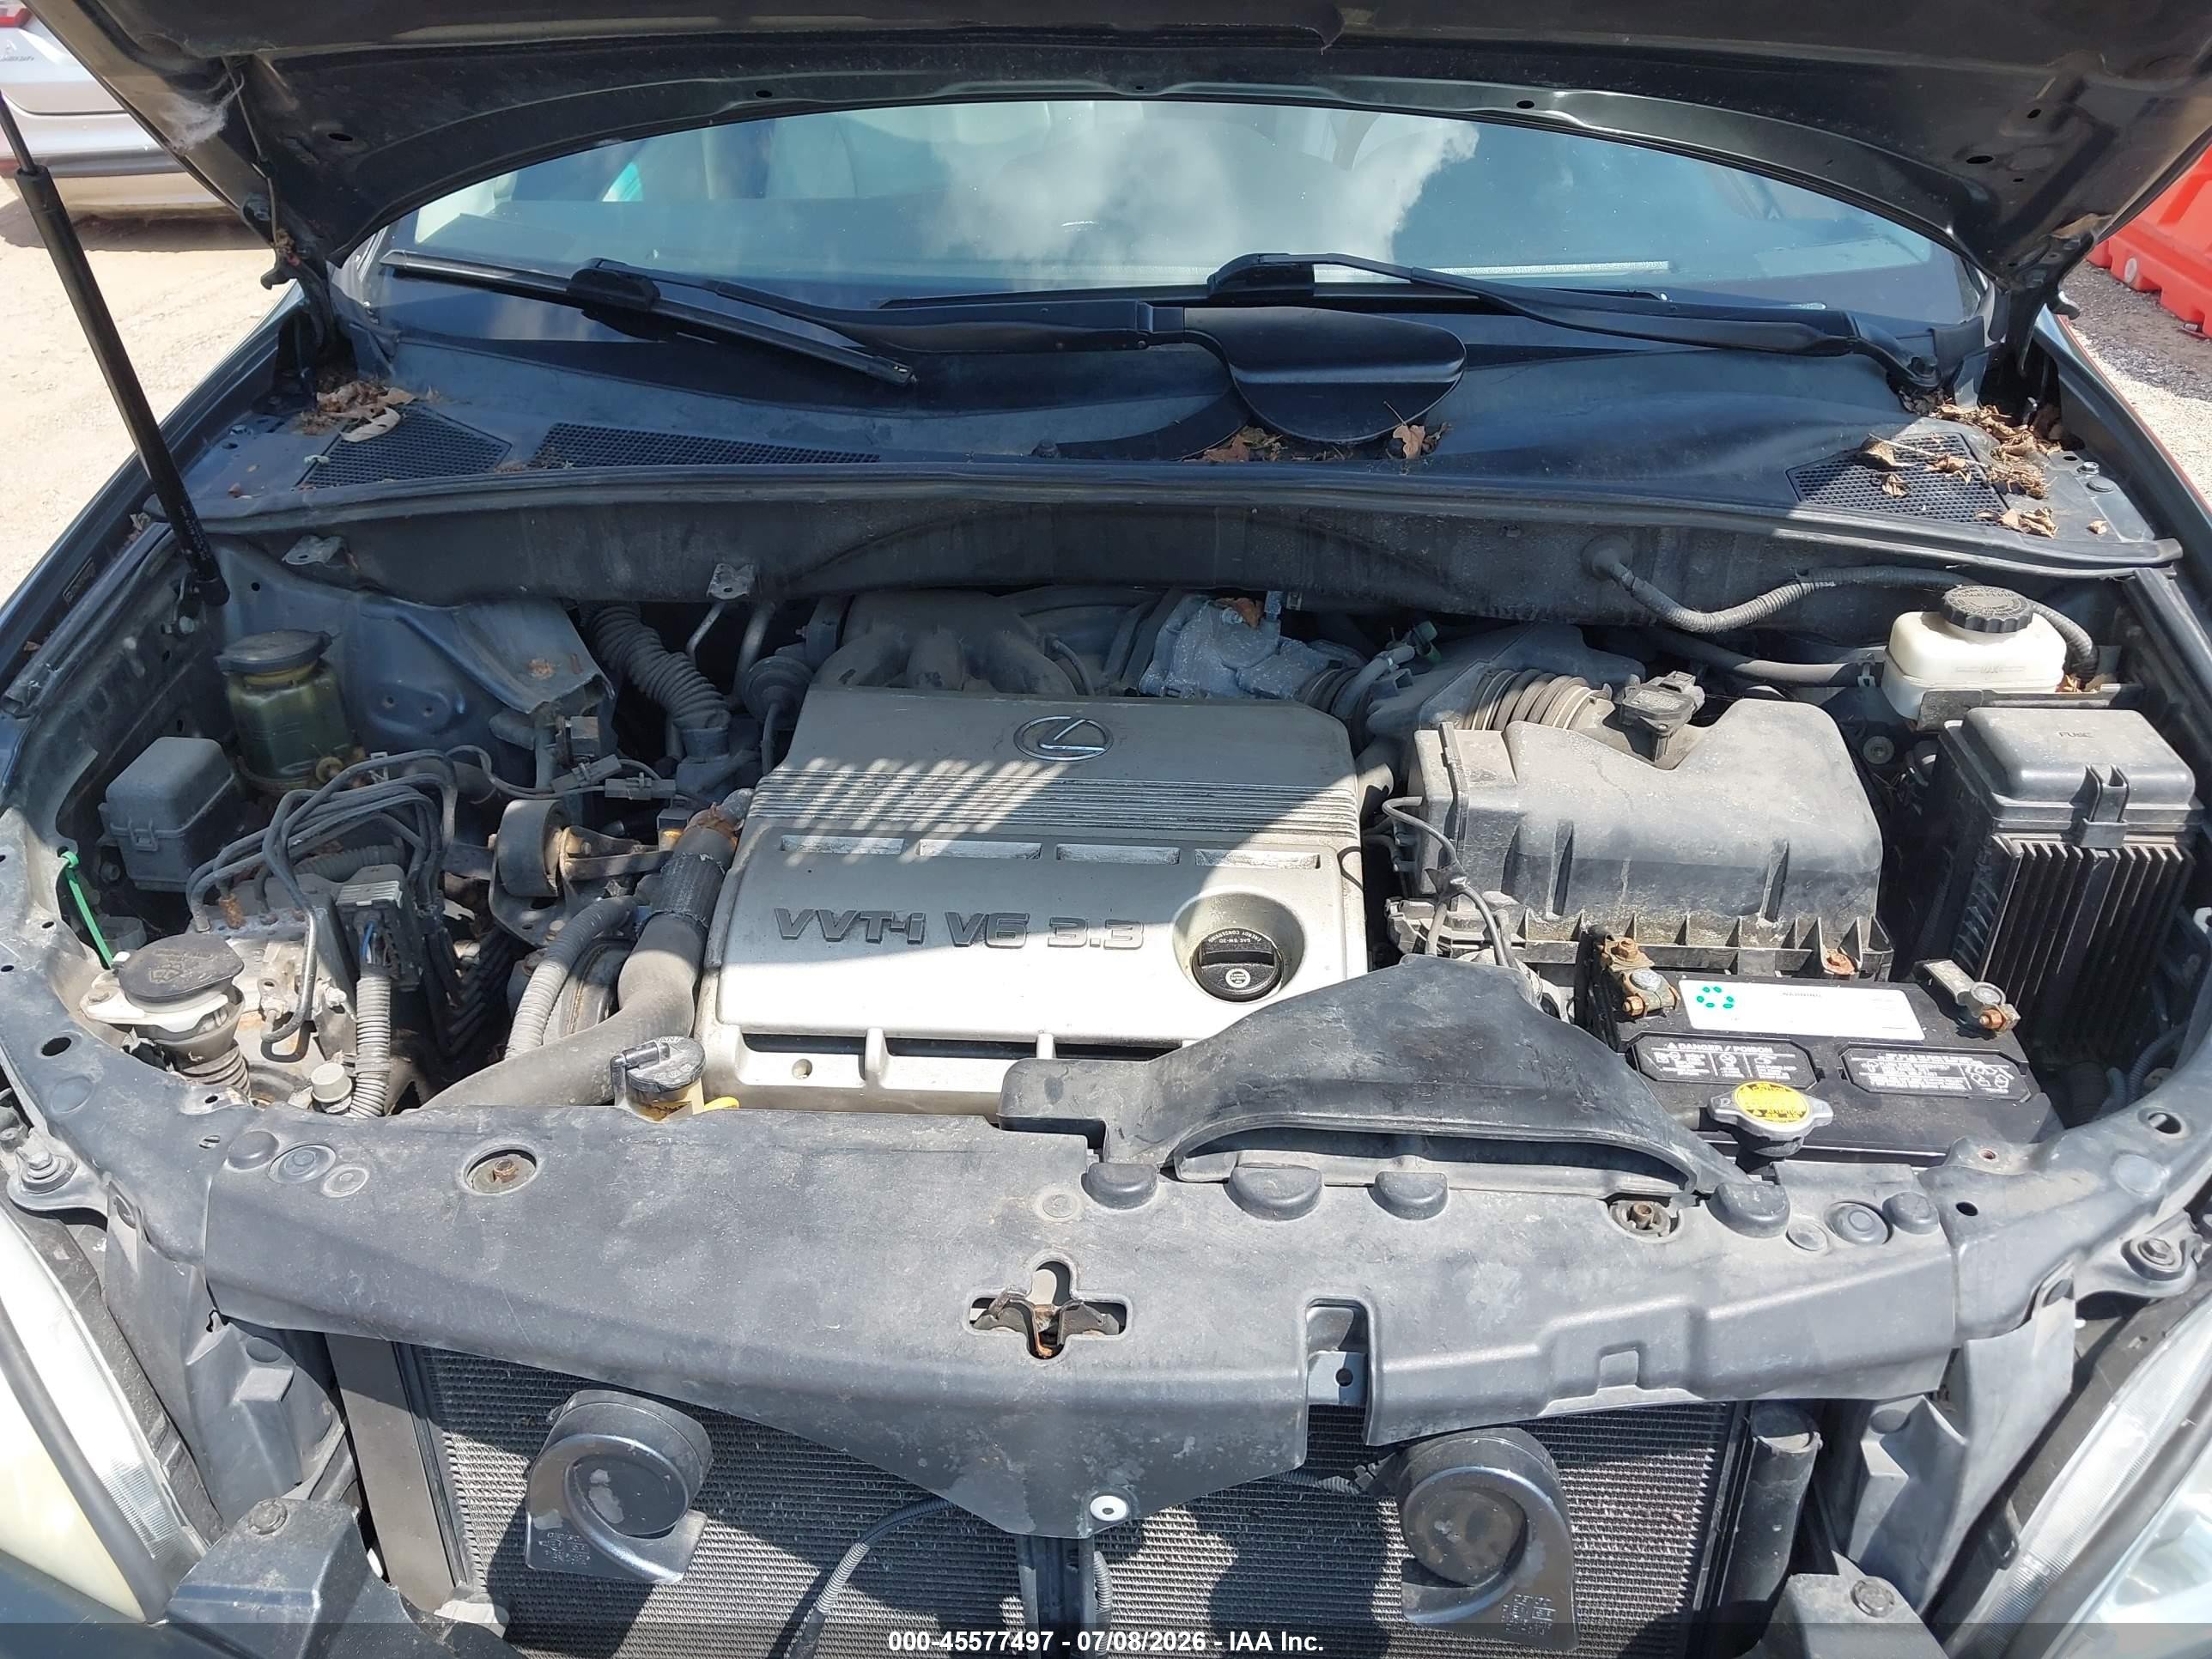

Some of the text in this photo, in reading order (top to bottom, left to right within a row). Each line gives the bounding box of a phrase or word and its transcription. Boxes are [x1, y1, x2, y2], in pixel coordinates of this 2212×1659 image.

[945, 911, 1030, 949] V6
[1048, 916, 1146, 951] 3.3
[1677, 1043, 1723, 1052] DANGER
